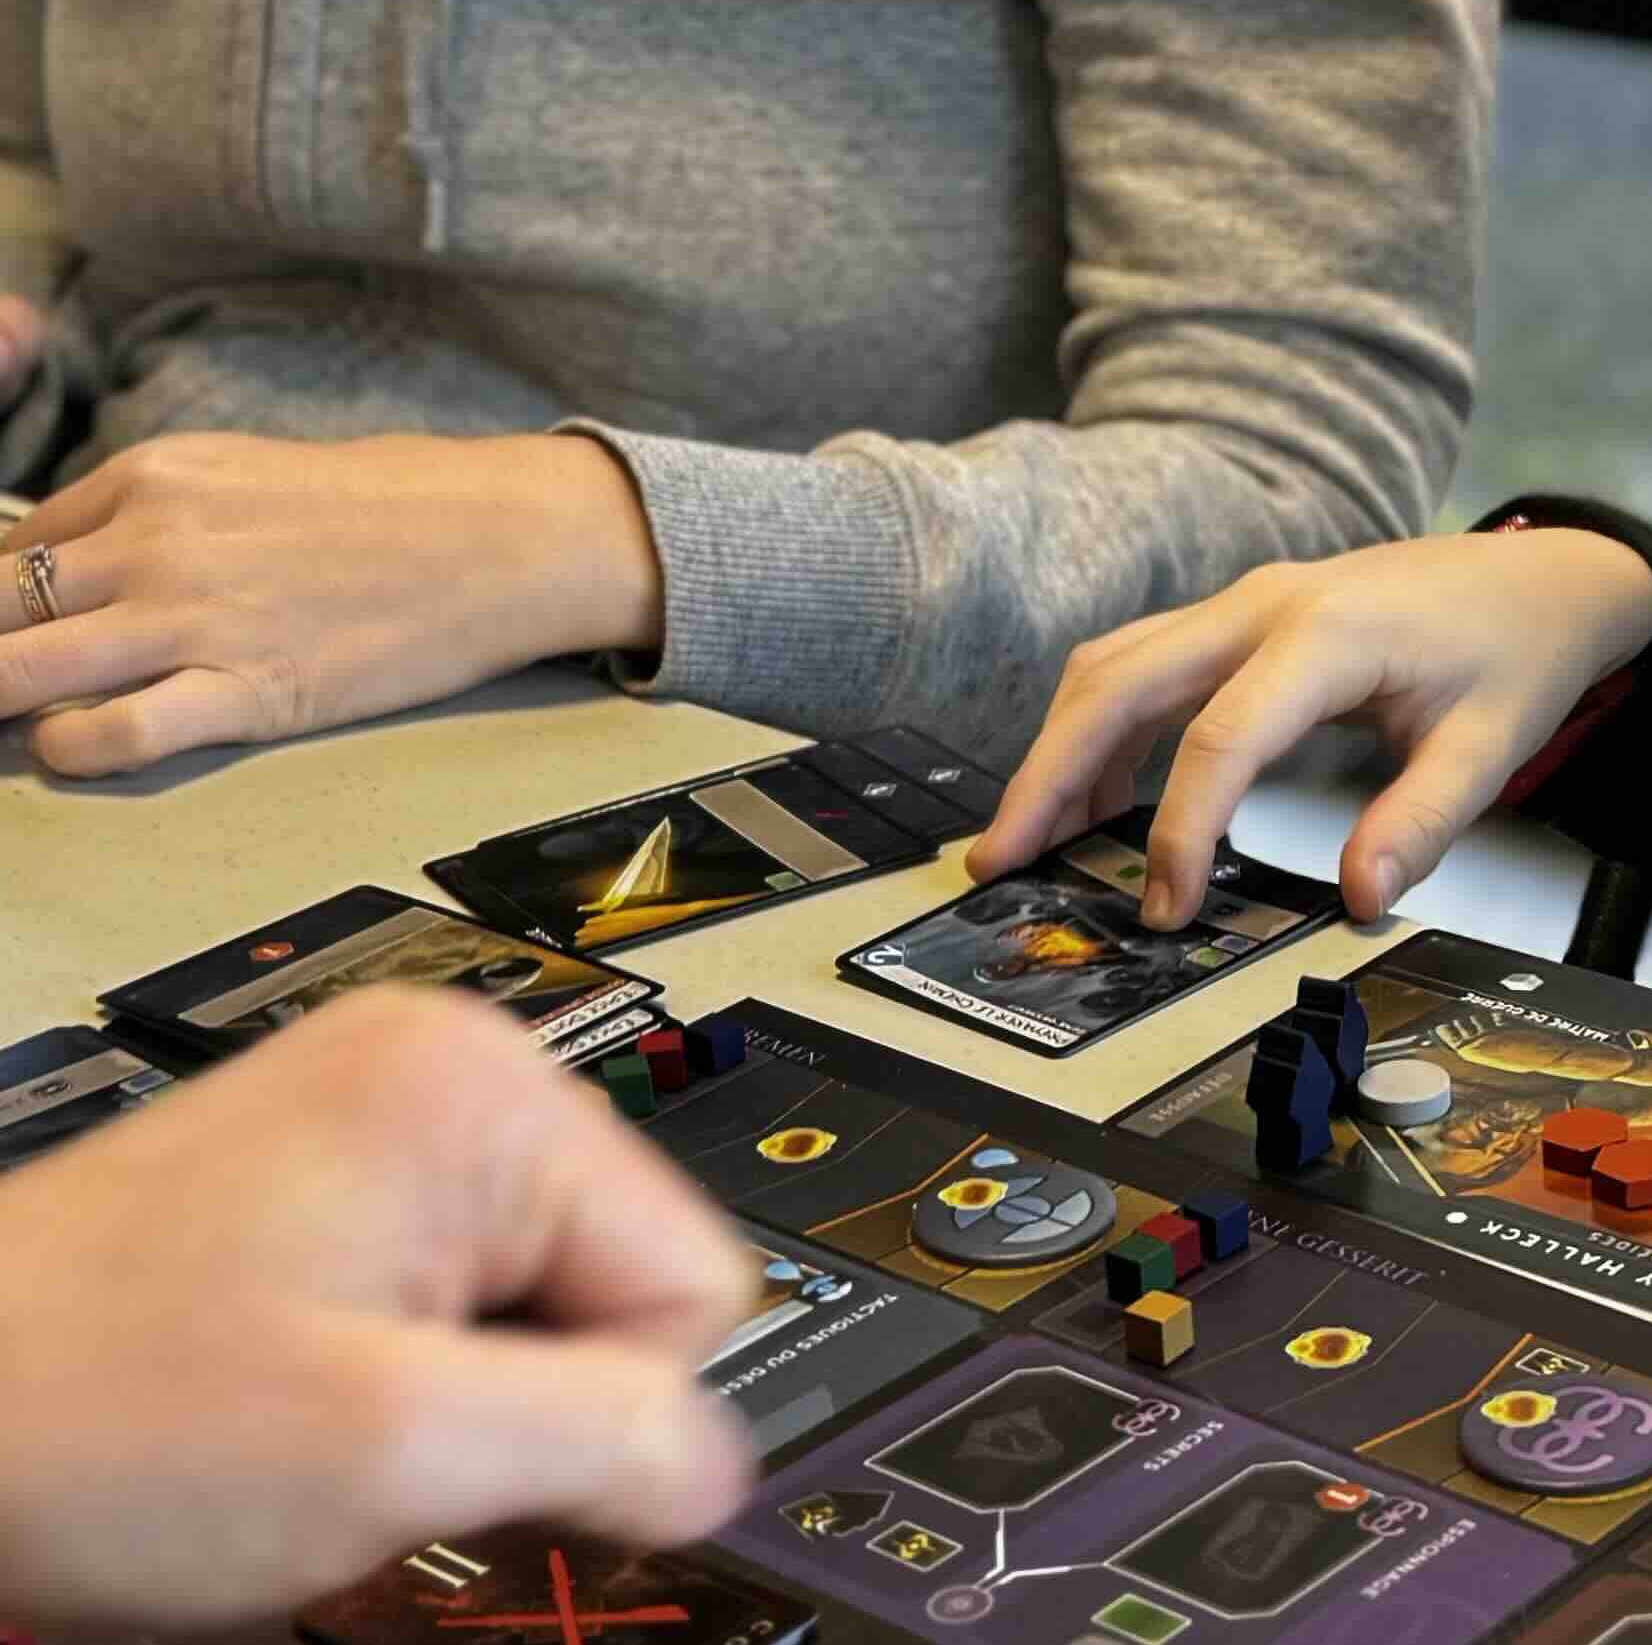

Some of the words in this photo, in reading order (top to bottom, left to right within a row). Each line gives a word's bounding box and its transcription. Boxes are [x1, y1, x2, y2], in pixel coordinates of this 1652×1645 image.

[866, 944, 904, 963] 2
[1524, 1011, 1549, 1023] DE
[1248, 1209, 1291, 1237] NE
[1479, 1219, 1626, 1278] HALLECK
[795, 1293, 899, 1351] TACTIQUES
[766, 1348, 798, 1368] DU
[1142, 1419, 1225, 1472] SECRETS
[1360, 1517, 1477, 1601] ESPIONNAGE
